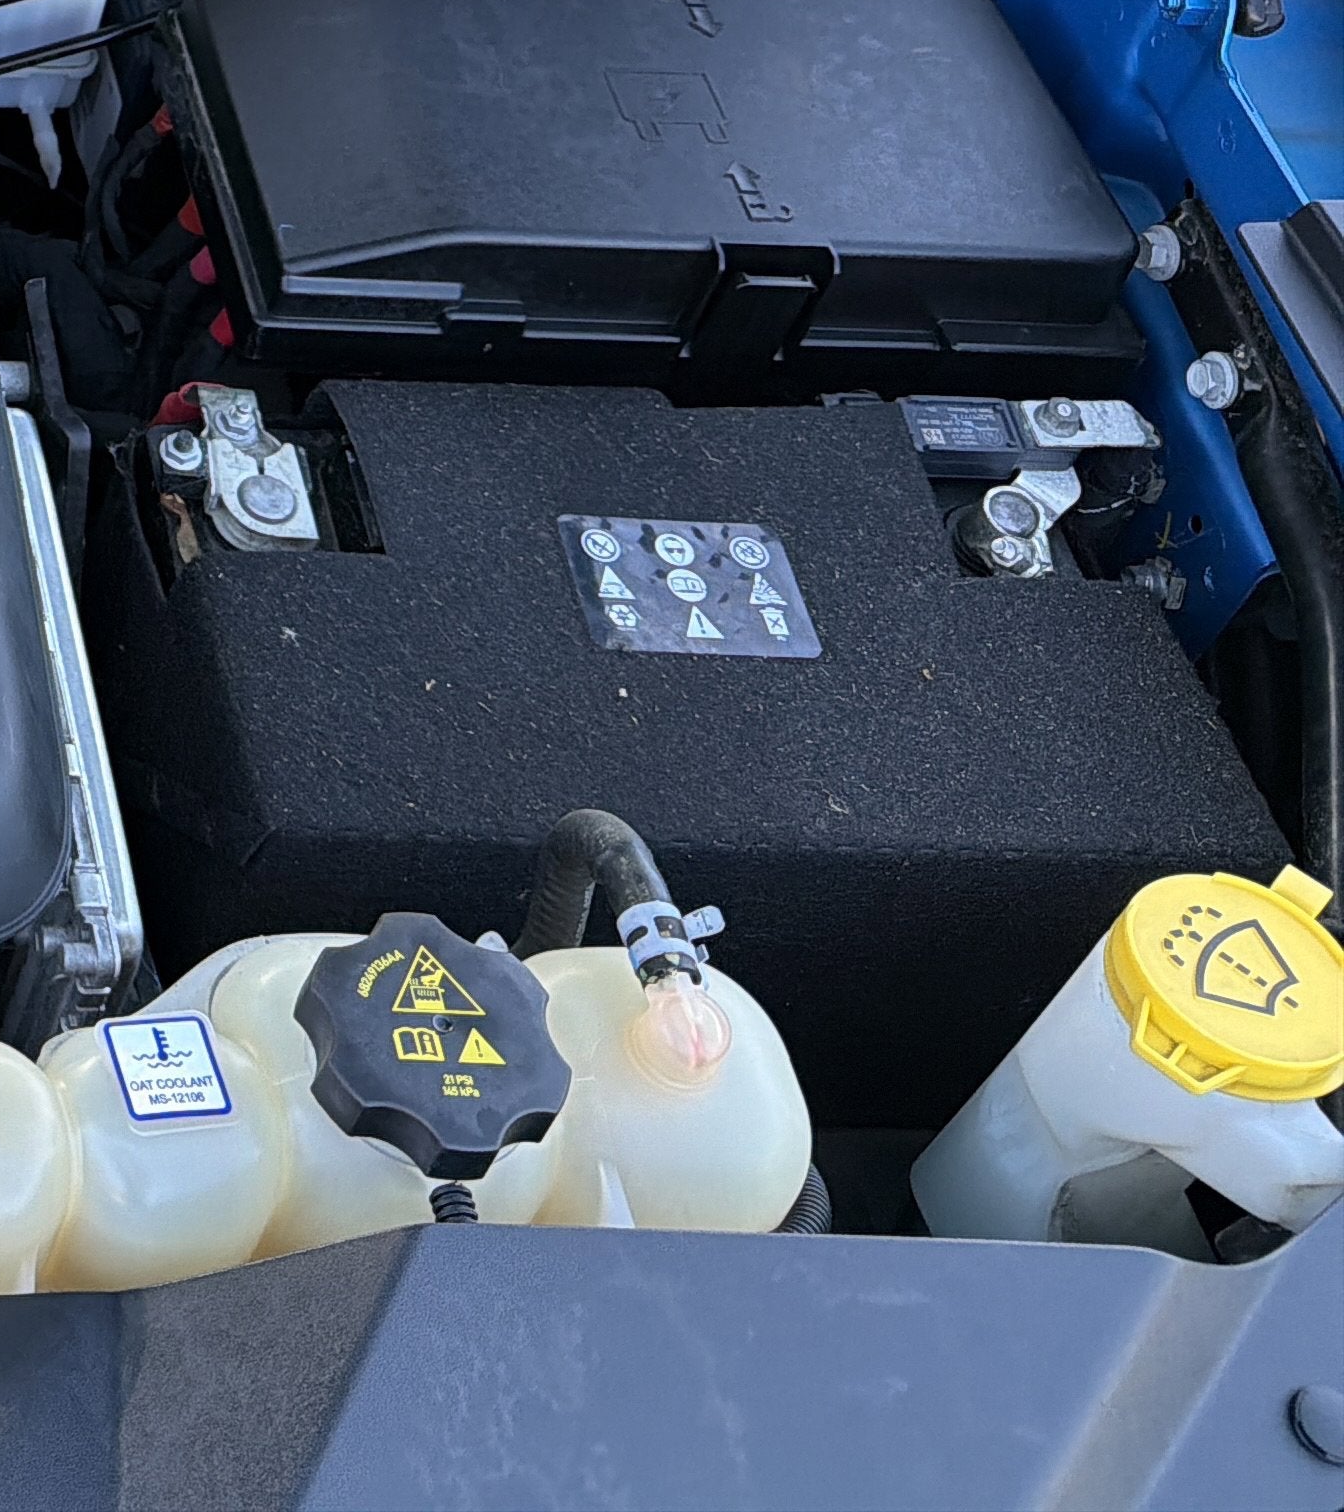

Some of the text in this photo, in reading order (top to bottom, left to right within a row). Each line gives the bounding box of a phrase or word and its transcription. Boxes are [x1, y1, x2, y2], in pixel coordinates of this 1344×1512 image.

[129, 1075, 214, 1092] OAT COOLANT
[455, 1074, 474, 1086] PSI
[459, 1086, 481, 1098] kPa
